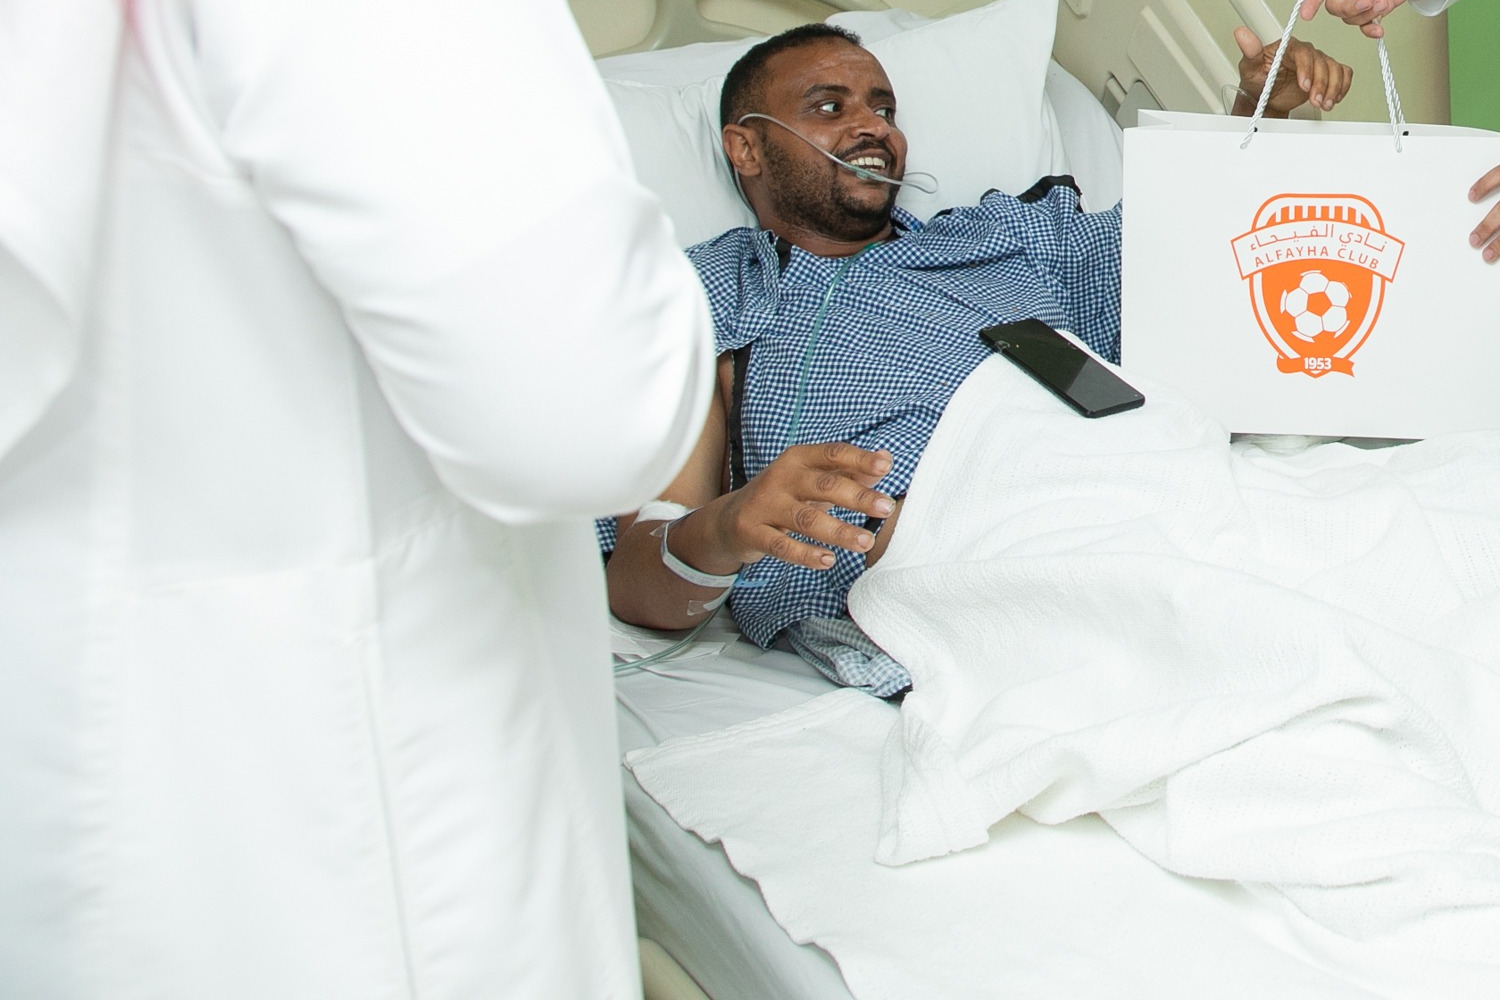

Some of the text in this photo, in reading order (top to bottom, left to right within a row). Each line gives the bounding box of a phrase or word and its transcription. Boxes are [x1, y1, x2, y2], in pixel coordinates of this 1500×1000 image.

[1250, 223, 1388, 253] نادي الفيحاء
[1254, 245, 1379, 270] ALFAYHA CLUB
[1304, 357, 1332, 370] 1953
